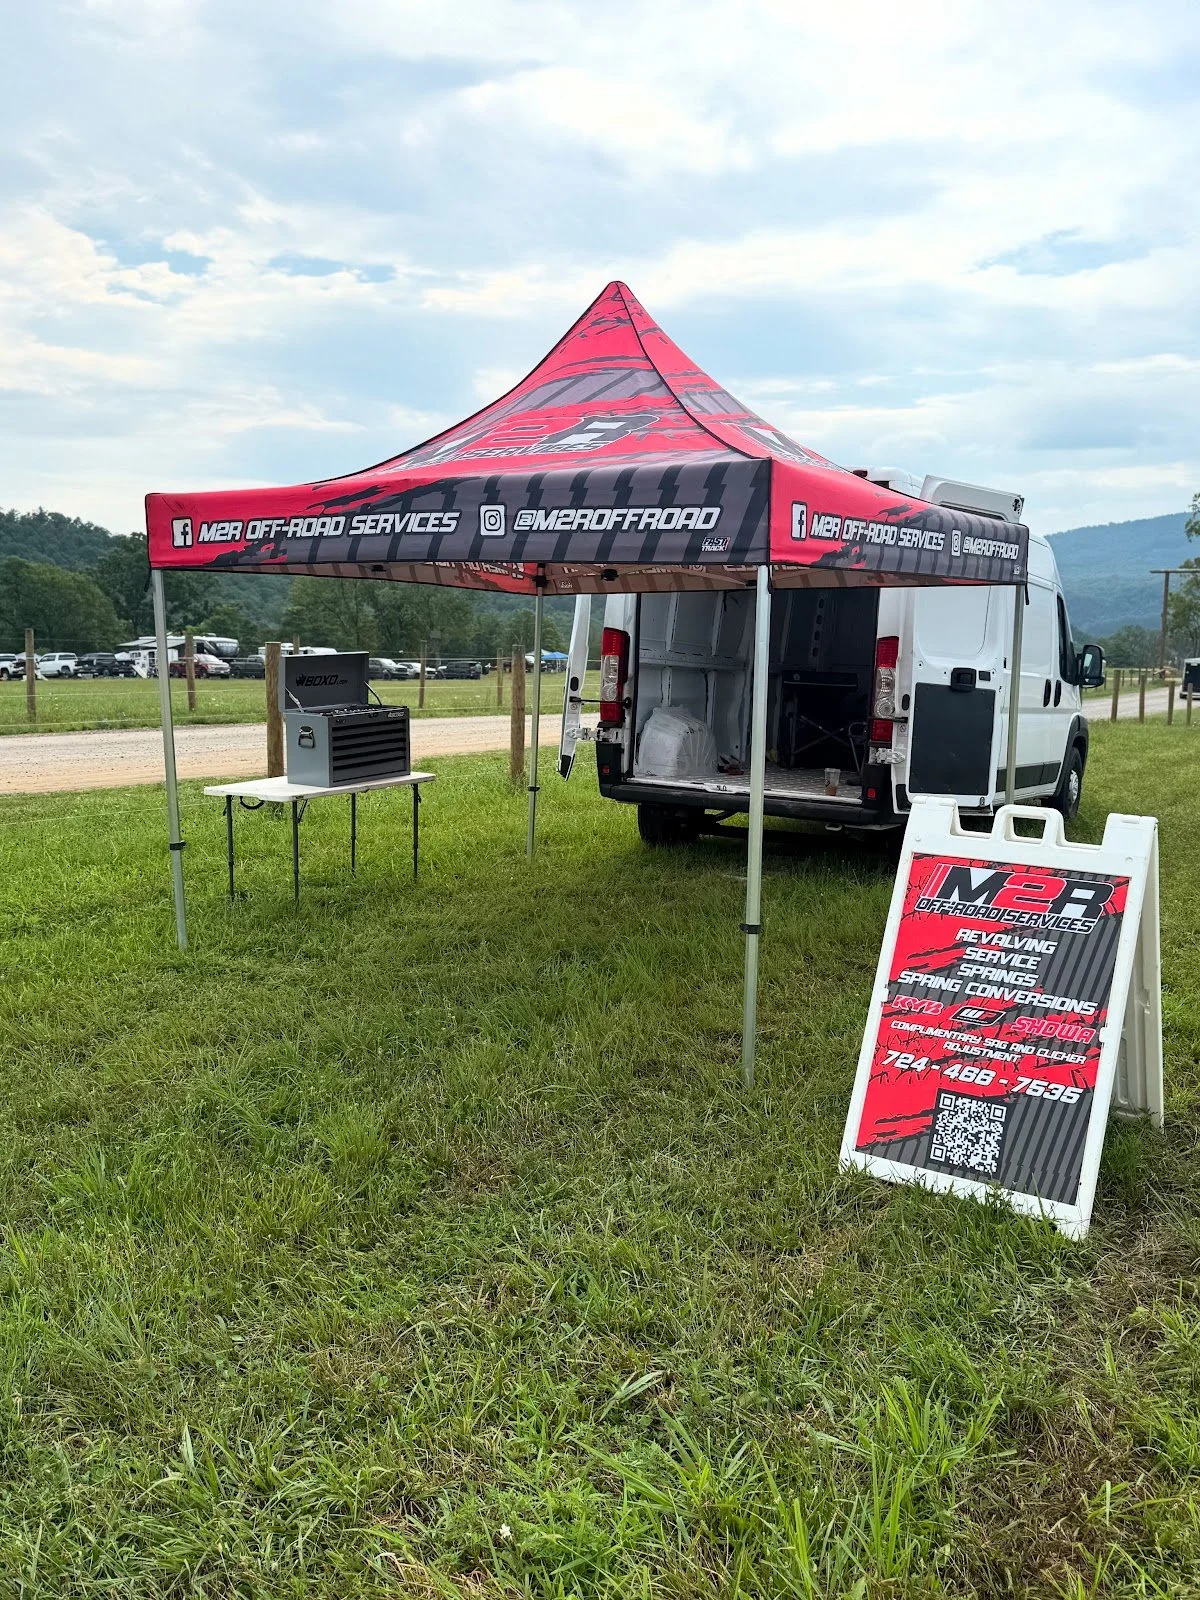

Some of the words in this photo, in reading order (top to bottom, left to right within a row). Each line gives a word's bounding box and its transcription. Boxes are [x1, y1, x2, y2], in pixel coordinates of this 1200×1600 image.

[198, 521, 244, 542] M2R
[245, 515, 345, 540] OFF-ROAD
[349, 512, 460, 535] SERVICES
[513, 507, 721, 531] @M2ROFFROAD
[810, 514, 842, 539] M2R
[842, 519, 898, 545] OFF-ROAD
[897, 527, 946, 551] SERVICES
[963, 536, 1019, 559] @M2ROFFROAD
[932, 864, 1115, 921] M2R
[916, 898, 1000, 921] OFF-ROAD
[1002, 911, 1097, 934] SERVICES
[957, 963, 1039, 988] SPRINGS
[962, 946, 1042, 970] SERVICE
[897, 970, 963, 993] SPRING
[964, 982, 1099, 1015] CONVERSIONS
[891, 995, 944, 1015] KYB
[1011, 1016, 1096, 1044] SHOWA
[890, 1020, 983, 1044] COMPLIMENTARY
[984, 1037, 1008, 1050] SAG
[1010, 1043, 1036, 1055] AND
[942, 1041, 1022, 1063] ADJUSTMENT
[881, 1050, 930, 1073] 724
[943, 1063, 996, 1087] 466
[1010, 1076, 1084, 1104] 7535
